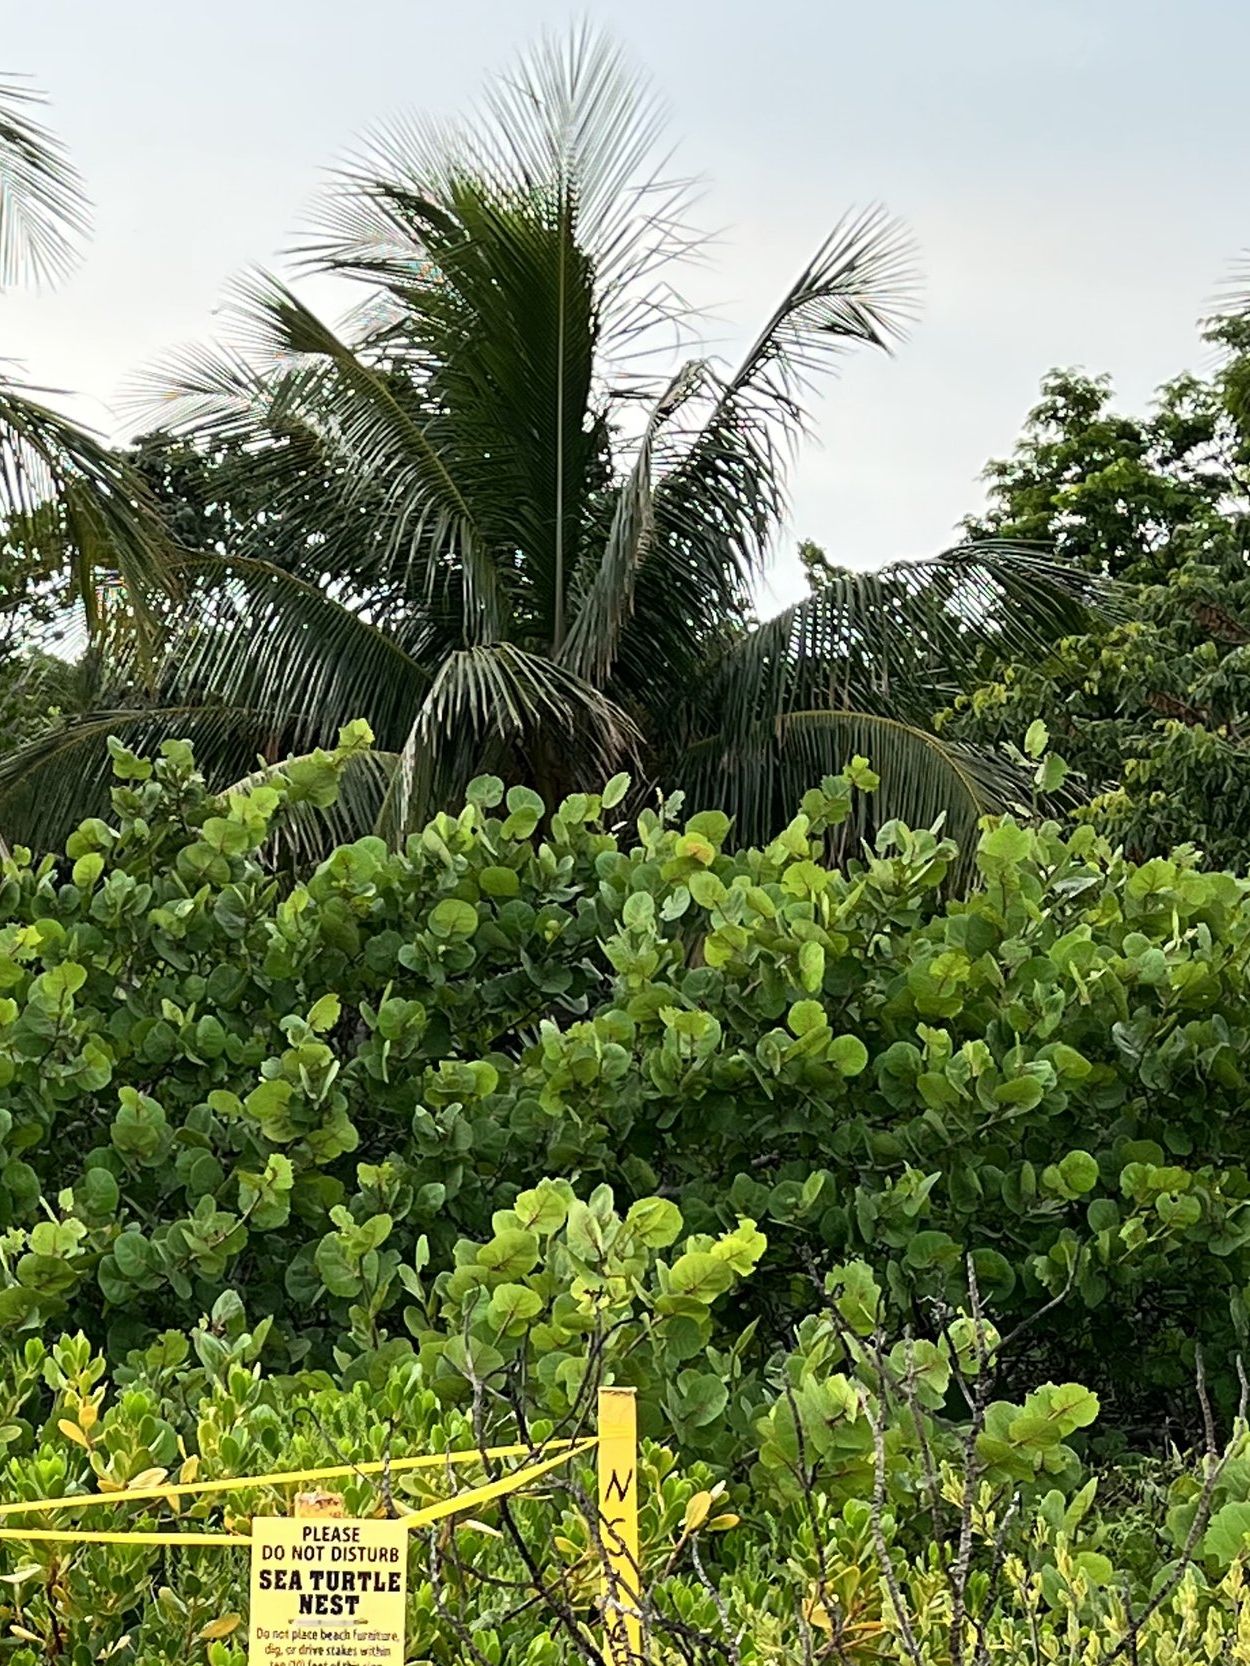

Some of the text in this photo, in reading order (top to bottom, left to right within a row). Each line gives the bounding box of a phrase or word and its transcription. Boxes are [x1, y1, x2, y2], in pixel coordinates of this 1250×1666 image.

[303, 1526, 360, 1543] PLEASE
[262, 1545, 399, 1563] DO NOT DISTURB
[259, 1569, 401, 1592] SEA TURTLE
[299, 1594, 360, 1616] NEST
[257, 1627, 270, 1639] Do
[273, 1628, 289, 1640] not
[292, 1628, 318, 1642] place
[320, 1628, 350, 1641] beach
[285, 1647, 297, 1655] or
[299, 1644, 324, 1656] drive
[326, 1644, 358, 1656] stakes
[360, 1645, 391, 1657] within
